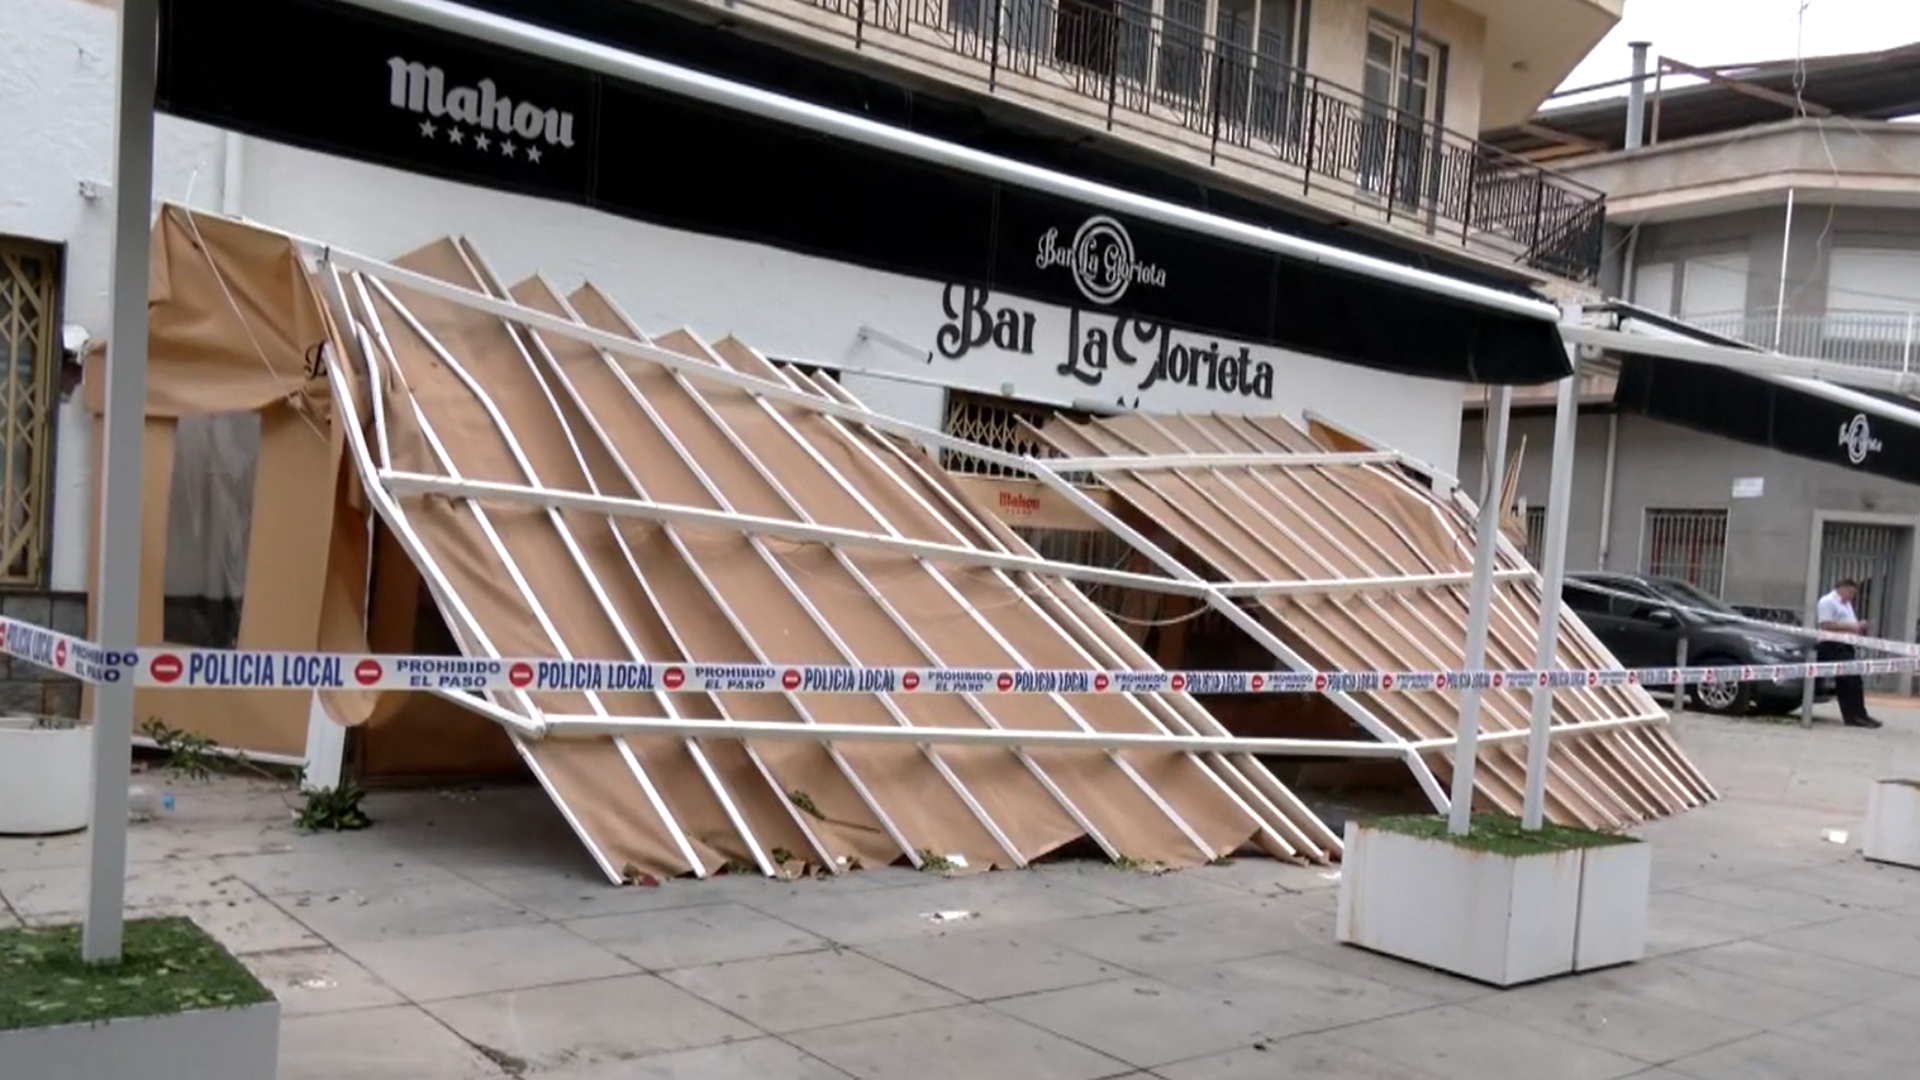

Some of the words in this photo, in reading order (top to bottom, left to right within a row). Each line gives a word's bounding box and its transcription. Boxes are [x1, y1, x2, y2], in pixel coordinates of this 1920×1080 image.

[387, 56, 575, 148] Mahou
[1036, 226, 1076, 269] Bar
[1079, 236, 1099, 281] La
[937, 283, 1036, 360] Bar
[1057, 308, 1108, 385] La
[999, 492, 1040, 510] Mahou
[189, 653, 275, 686] POLICIA
[282, 656, 344, 687] LOCAL
[397, 660, 501, 675] PROHIBIDO
[537, 663, 602, 690] POLICIA
[607, 664, 655, 690] LOCAL
[695, 666, 775, 679] PROHIBIDO
[928, 671, 993, 682] PROHIBIDO
[410, 675, 432, 687] EL
[438, 675, 487, 688] PASO
[704, 679, 722, 690] EL
[727, 679, 765, 690] PASO
[803, 668, 856, 692] POLICIA
[858, 669, 895, 692] LOCAL
[935, 682, 949, 692] EL
[1013, 672, 1056, 692] POLICIA
[1057, 673, 1088, 692] LOCAL
